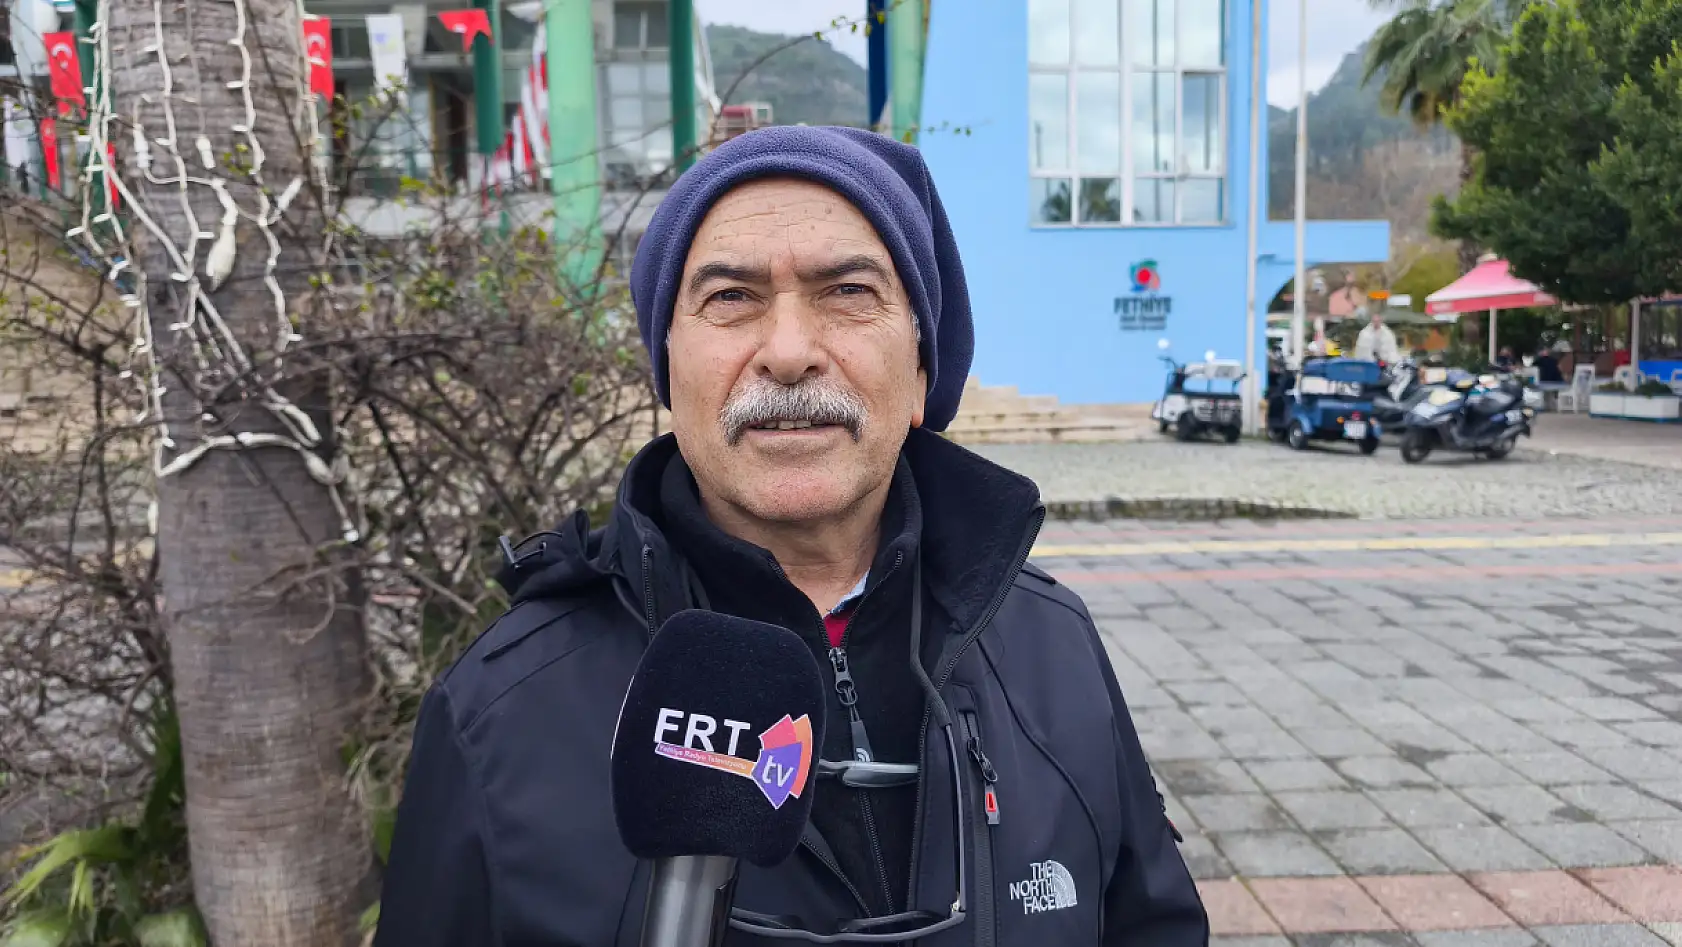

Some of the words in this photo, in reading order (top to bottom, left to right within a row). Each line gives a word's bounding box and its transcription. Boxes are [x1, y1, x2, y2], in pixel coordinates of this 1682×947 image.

[654, 708, 751, 756] FRT
[762, 755, 795, 788] tv
[1029, 861, 1052, 880] THE
[1009, 878, 1053, 900] NORTH
[1023, 895, 1055, 914] FACE
